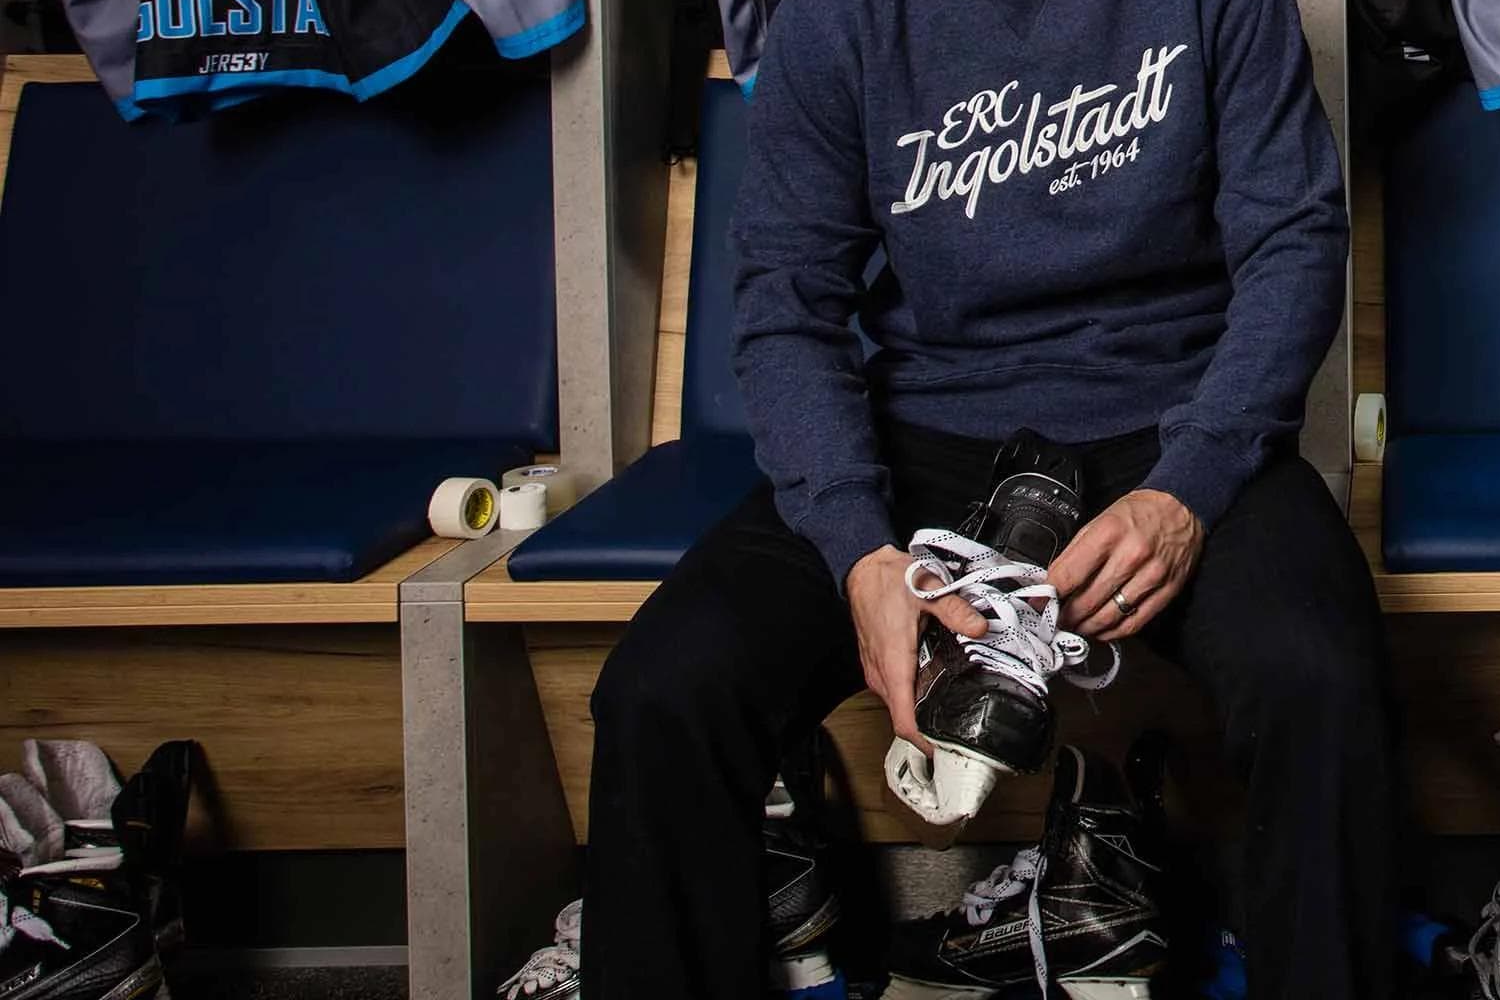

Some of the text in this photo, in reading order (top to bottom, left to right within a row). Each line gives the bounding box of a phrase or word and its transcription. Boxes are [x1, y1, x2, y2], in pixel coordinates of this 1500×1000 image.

[199, 52, 271, 75] JER53Y
[891, 44, 1188, 220] Ingolstadt
[937, 80, 1024, 150] ERC
[1089, 136, 1140, 178] 1964
